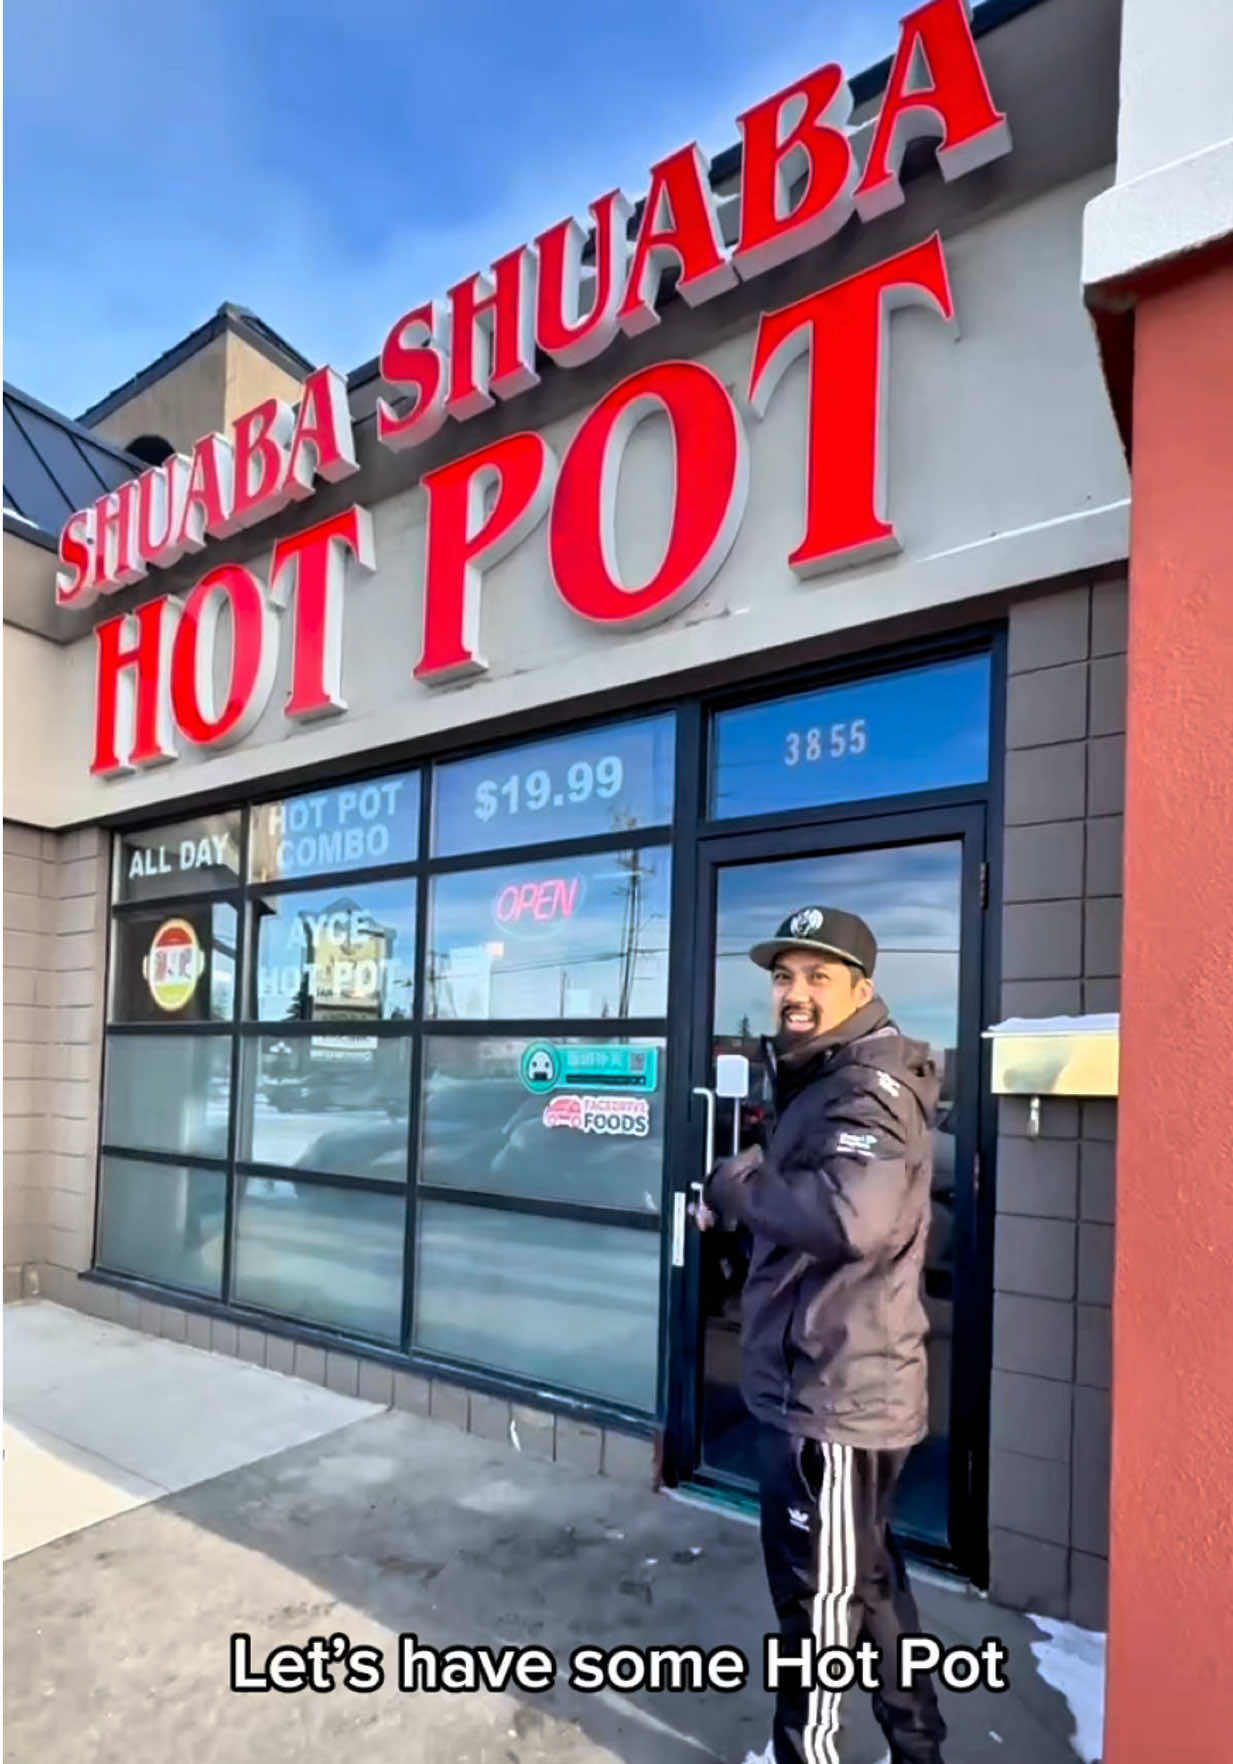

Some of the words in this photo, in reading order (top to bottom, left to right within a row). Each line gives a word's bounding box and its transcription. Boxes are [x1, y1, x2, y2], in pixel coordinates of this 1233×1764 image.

[56, 366, 360, 606] SHUABA
[377, 0, 1012, 452] SHUABA
[90, 505, 376, 778] HOT
[413, 230, 961, 686] POT
[784, 720, 867, 766] 3855
[268, 797, 330, 836] HOT
[337, 780, 403, 824] POT
[474, 756, 624, 823] $19.99
[129, 844, 172, 879] ALL
[179, 832, 230, 870] DAY
[278, 824, 389, 870] COMBO
[496, 878, 579, 922] OPEN
[286, 909, 372, 950] AYCE
[257, 960, 318, 1000] HOT
[334, 958, 402, 996] POT
[584, 1112, 647, 1133] FOODS
